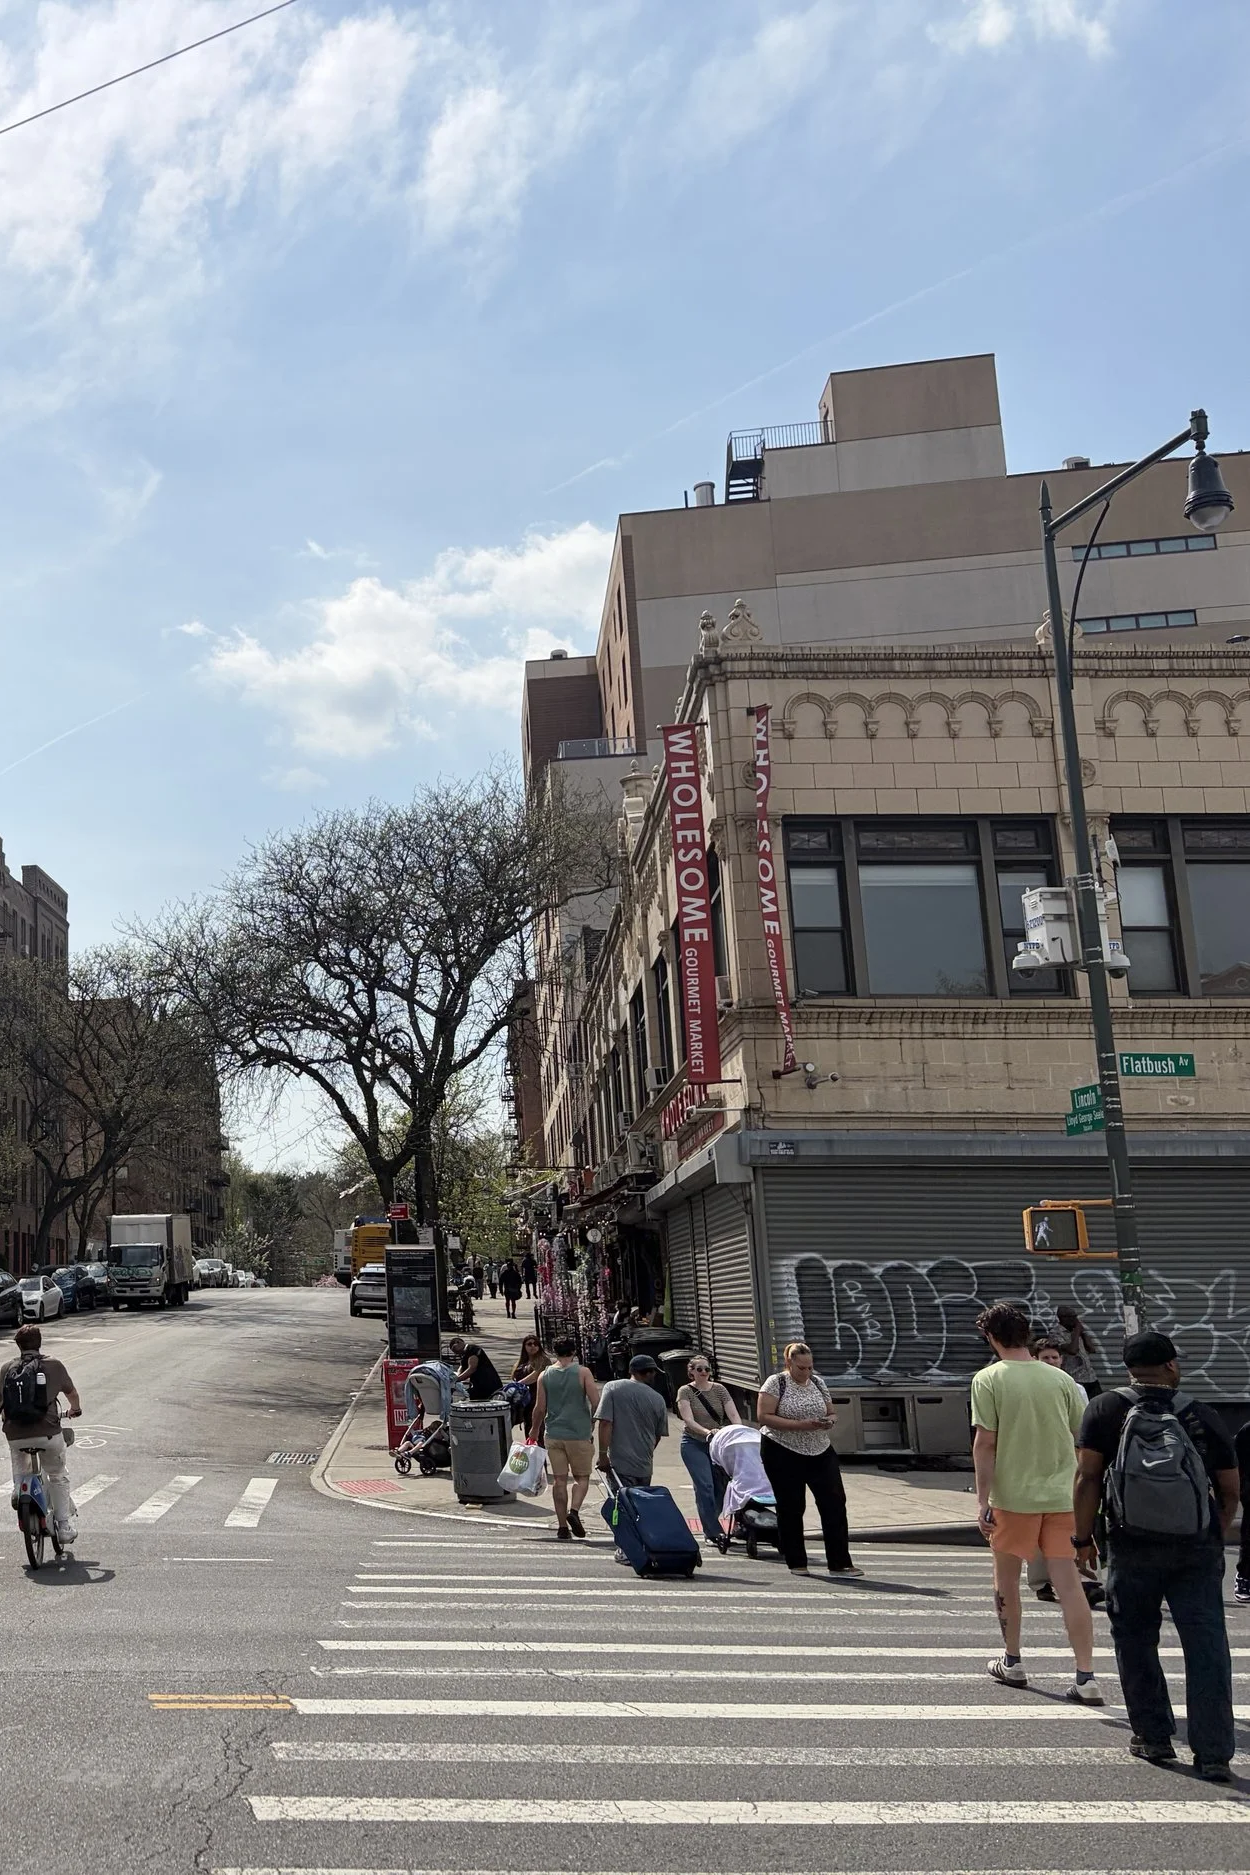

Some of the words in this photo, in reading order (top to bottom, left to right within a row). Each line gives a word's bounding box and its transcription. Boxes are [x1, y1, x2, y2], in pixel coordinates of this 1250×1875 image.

[668, 729, 709, 942] WHOLESOME
[767, 939, 785, 1007] GOURMET
[1023, 942, 1040, 950] NYPD
[685, 947, 700, 1014] GOURMET
[689, 1020, 705, 1074] MARKET
[1122, 1056, 1175, 1073] Flatbush
[1179, 1056, 1188, 1066] Av
[1074, 1089, 1096, 1108] Lincoln
